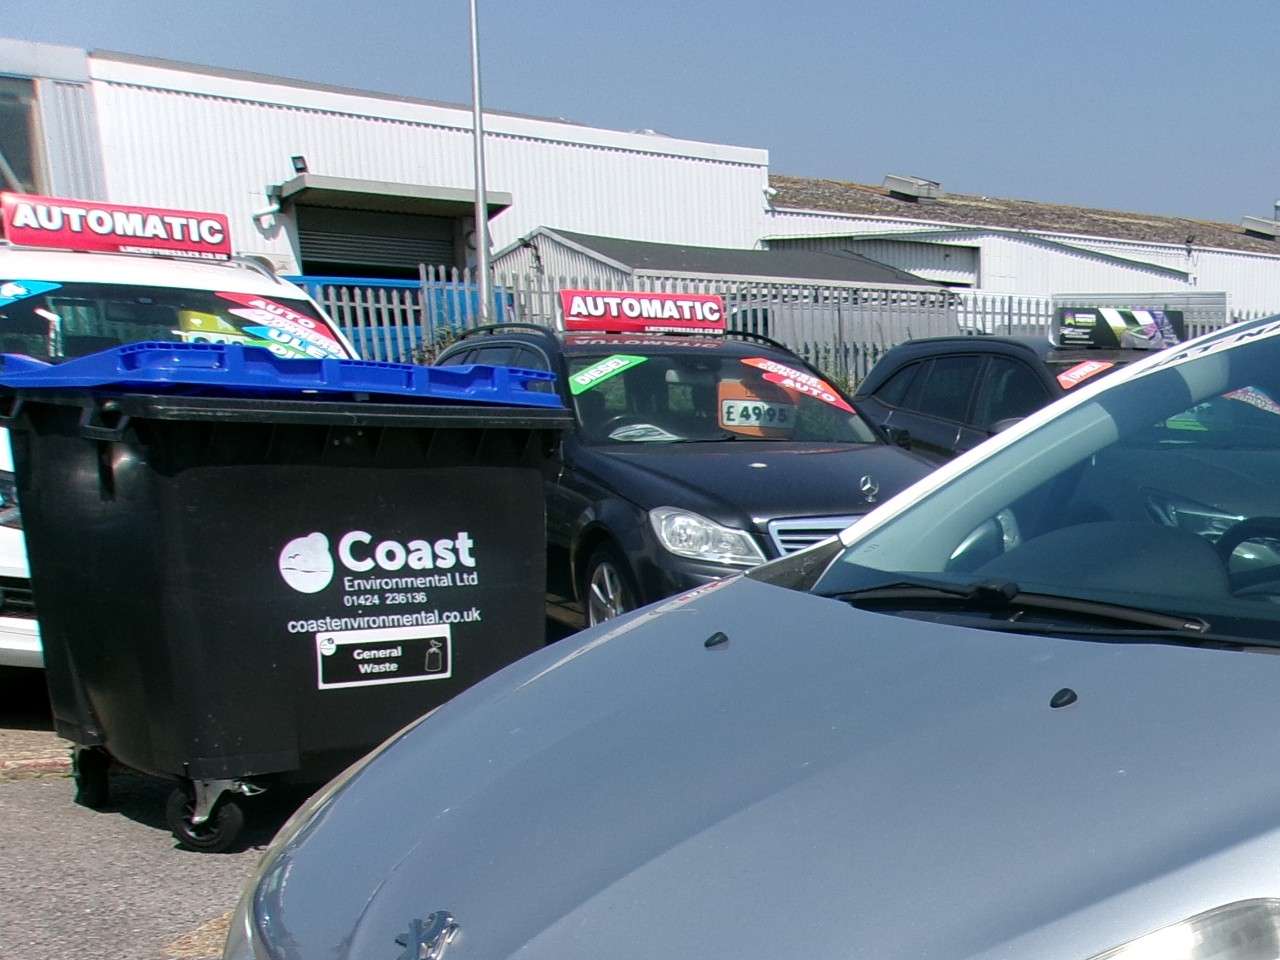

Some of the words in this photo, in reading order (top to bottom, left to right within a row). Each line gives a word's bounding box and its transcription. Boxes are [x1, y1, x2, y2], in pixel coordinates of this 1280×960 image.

[13, 204, 224, 244] AUTOMATIC
[248, 299, 317, 329] AUTO
[569, 294, 722, 321] AUTOMATIC
[267, 327, 340, 359] ULE
[781, 378, 837, 403] AUTO
[338, 530, 476, 572] Coast
[344, 573, 453, 591] Environmental
[455, 571, 479, 586] Ltd
[344, 595, 380, 607] 01424
[385, 592, 428, 605] 236136
[287, 607, 482, 634] coastenvironmental.co.uk
[353, 646, 403, 660] General
[358, 662, 400, 675] Waste
